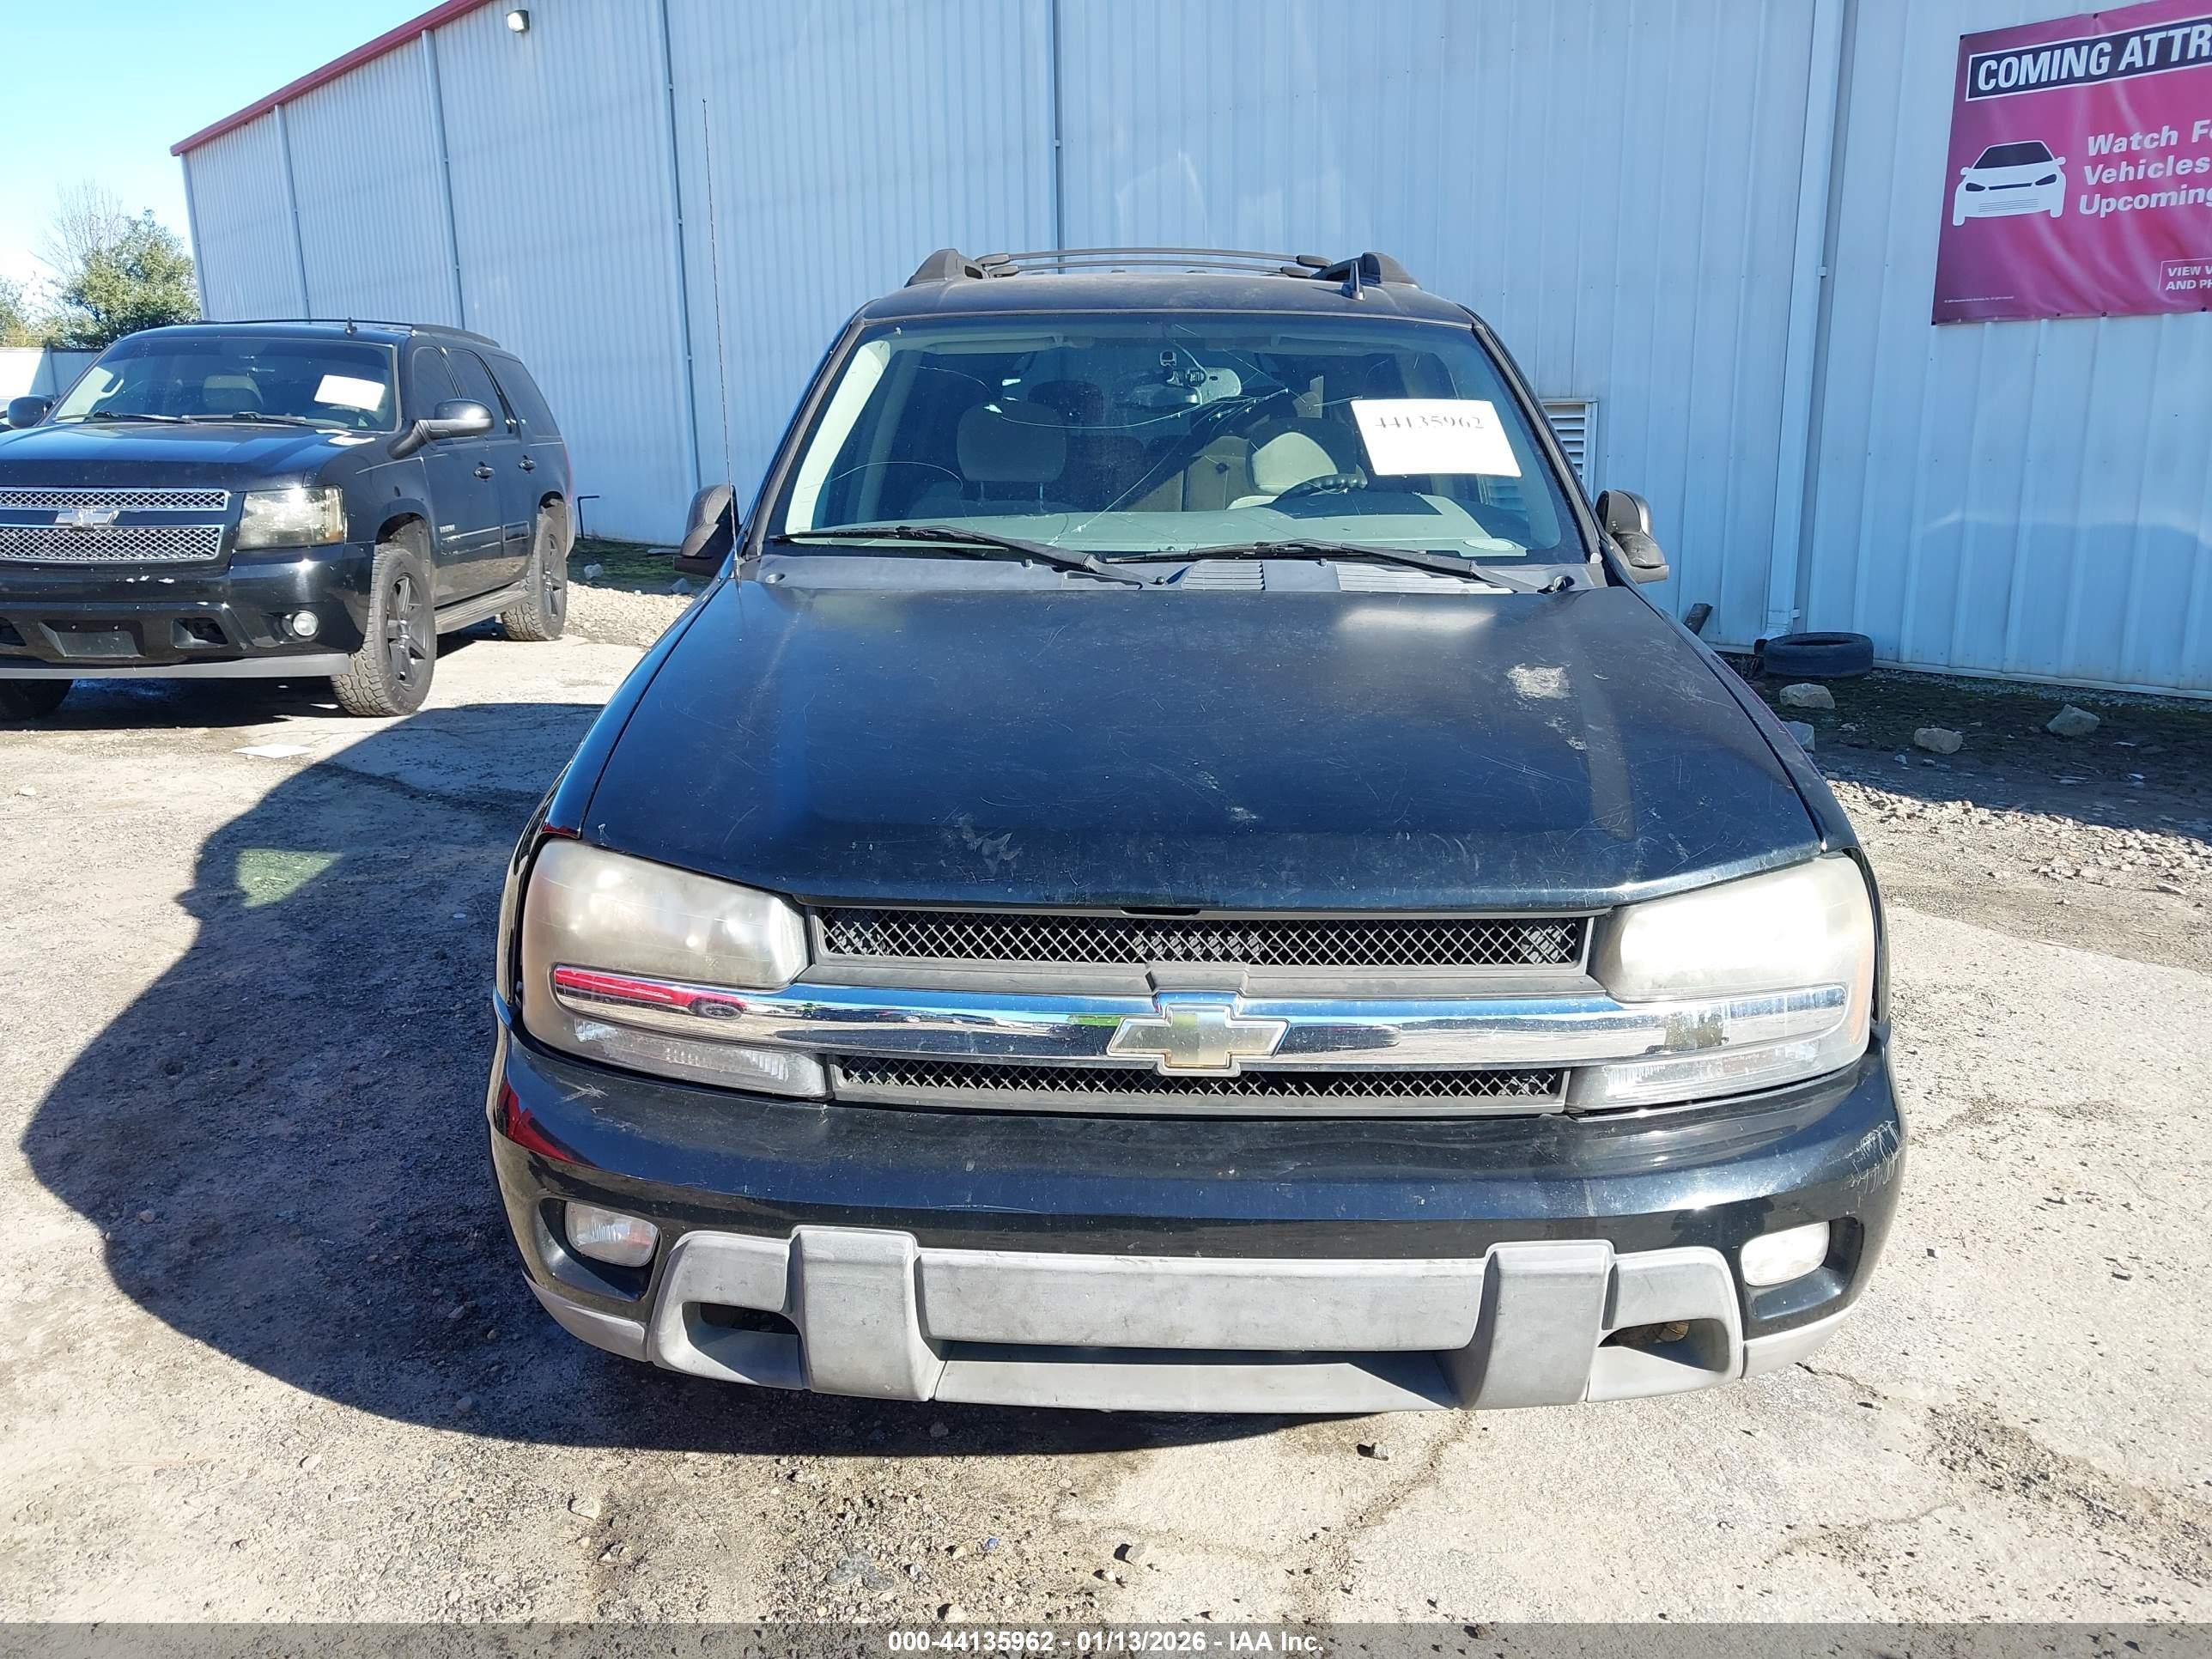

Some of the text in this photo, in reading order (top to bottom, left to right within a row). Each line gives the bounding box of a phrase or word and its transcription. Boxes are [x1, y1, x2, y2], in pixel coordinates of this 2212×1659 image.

[1978, 23, 2212, 91] COMING ATTR
[2087, 119, 2212, 156] Watch F
[2083, 155, 2211, 185] Vehicles
[2166, 279, 2197, 290] AND
[2167, 265, 2202, 276] VIEW
